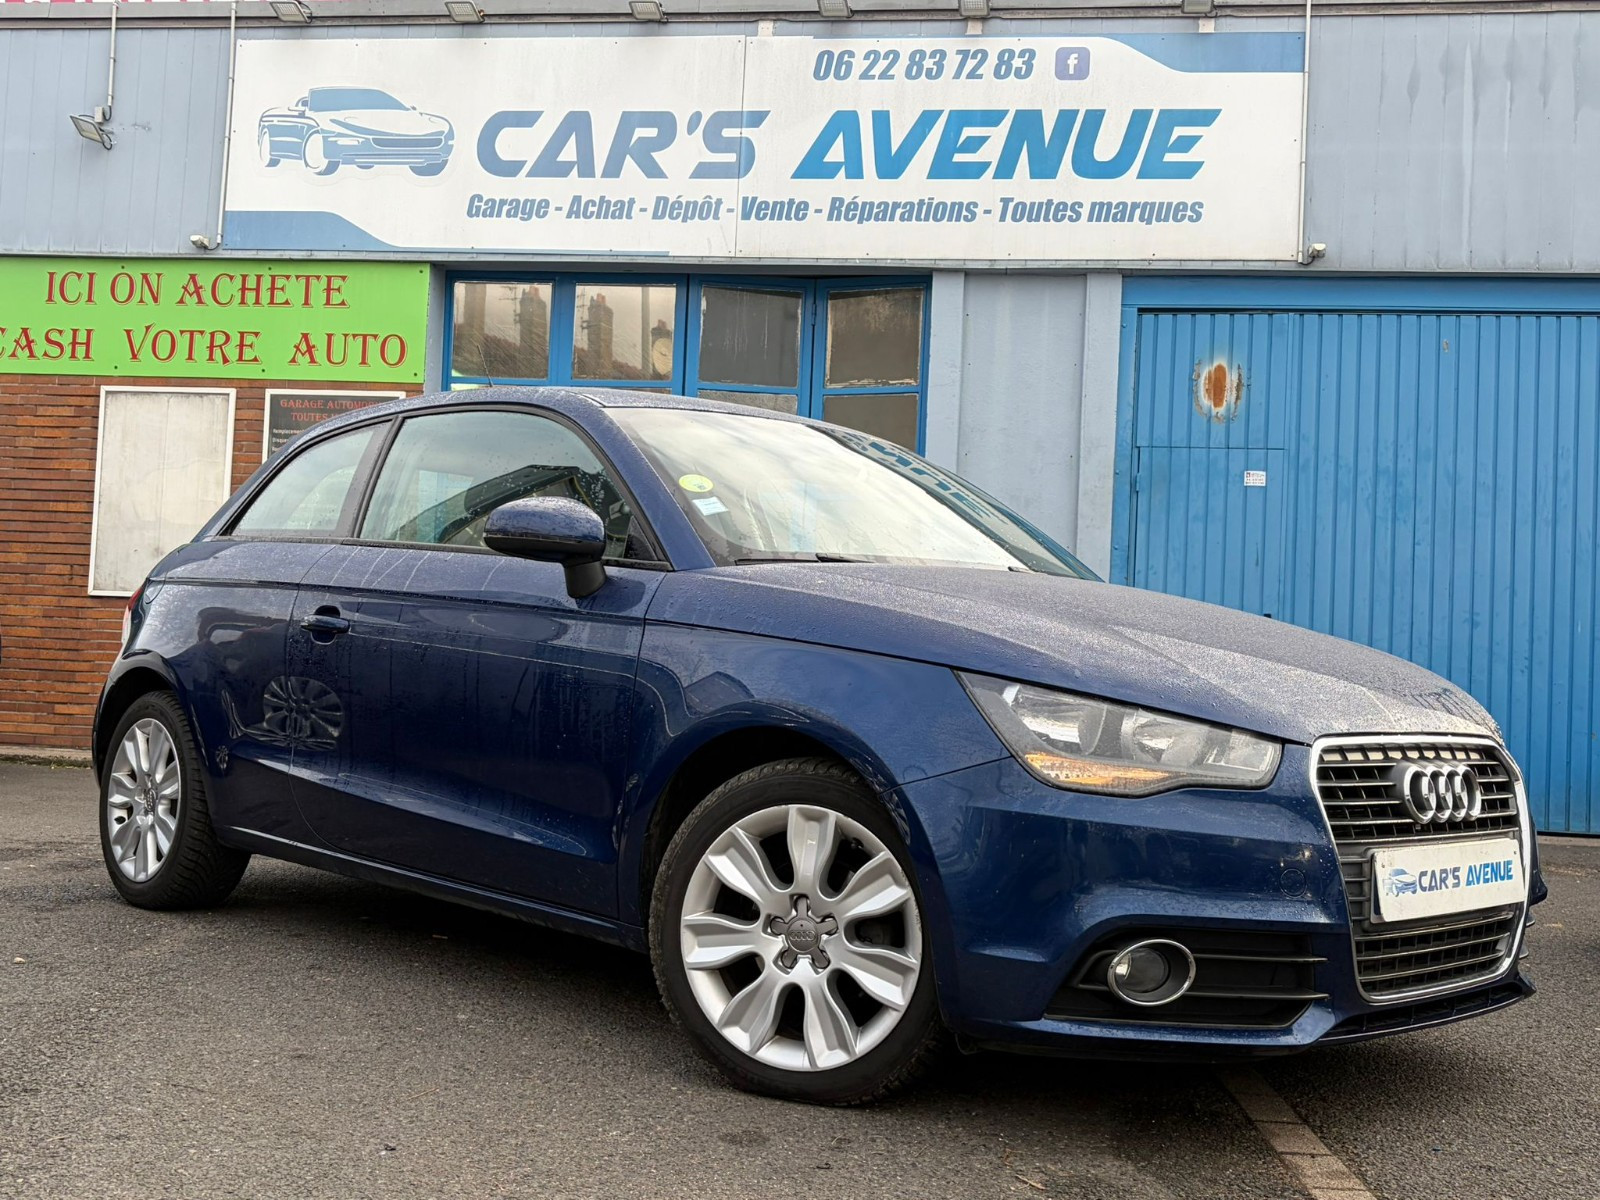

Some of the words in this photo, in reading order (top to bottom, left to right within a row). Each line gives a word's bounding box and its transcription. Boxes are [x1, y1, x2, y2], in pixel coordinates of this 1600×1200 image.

[813, 50, 856, 81] 06
[858, 50, 901, 81] 22
[904, 49, 948, 81] 83
[952, 48, 989, 80] 72
[993, 48, 1036, 80] 83
[477, 110, 771, 179] CAR'S
[791, 109, 1222, 180] AVENUE
[466, 193, 550, 221] Garage
[565, 195, 636, 221] Achat
[651, 195, 723, 223] Dépôt
[740, 196, 810, 221] Vente
[826, 196, 979, 225] Réparations
[998, 197, 1082, 223] Toutes
[1087, 200, 1205, 225] marques
[45, 271, 97, 305] ICI
[110, 272, 165, 305] ON
[176, 273, 350, 309] ACHETE
[123, 322, 262, 366] VOTRE
[288, 332, 408, 368] AUTO
[280, 399, 324, 409] GARAGE
[291, 412, 328, 422] TOUTES
[1418, 866, 1461, 892] CAR'S
[1465, 859, 1513, 886] AVENUE
